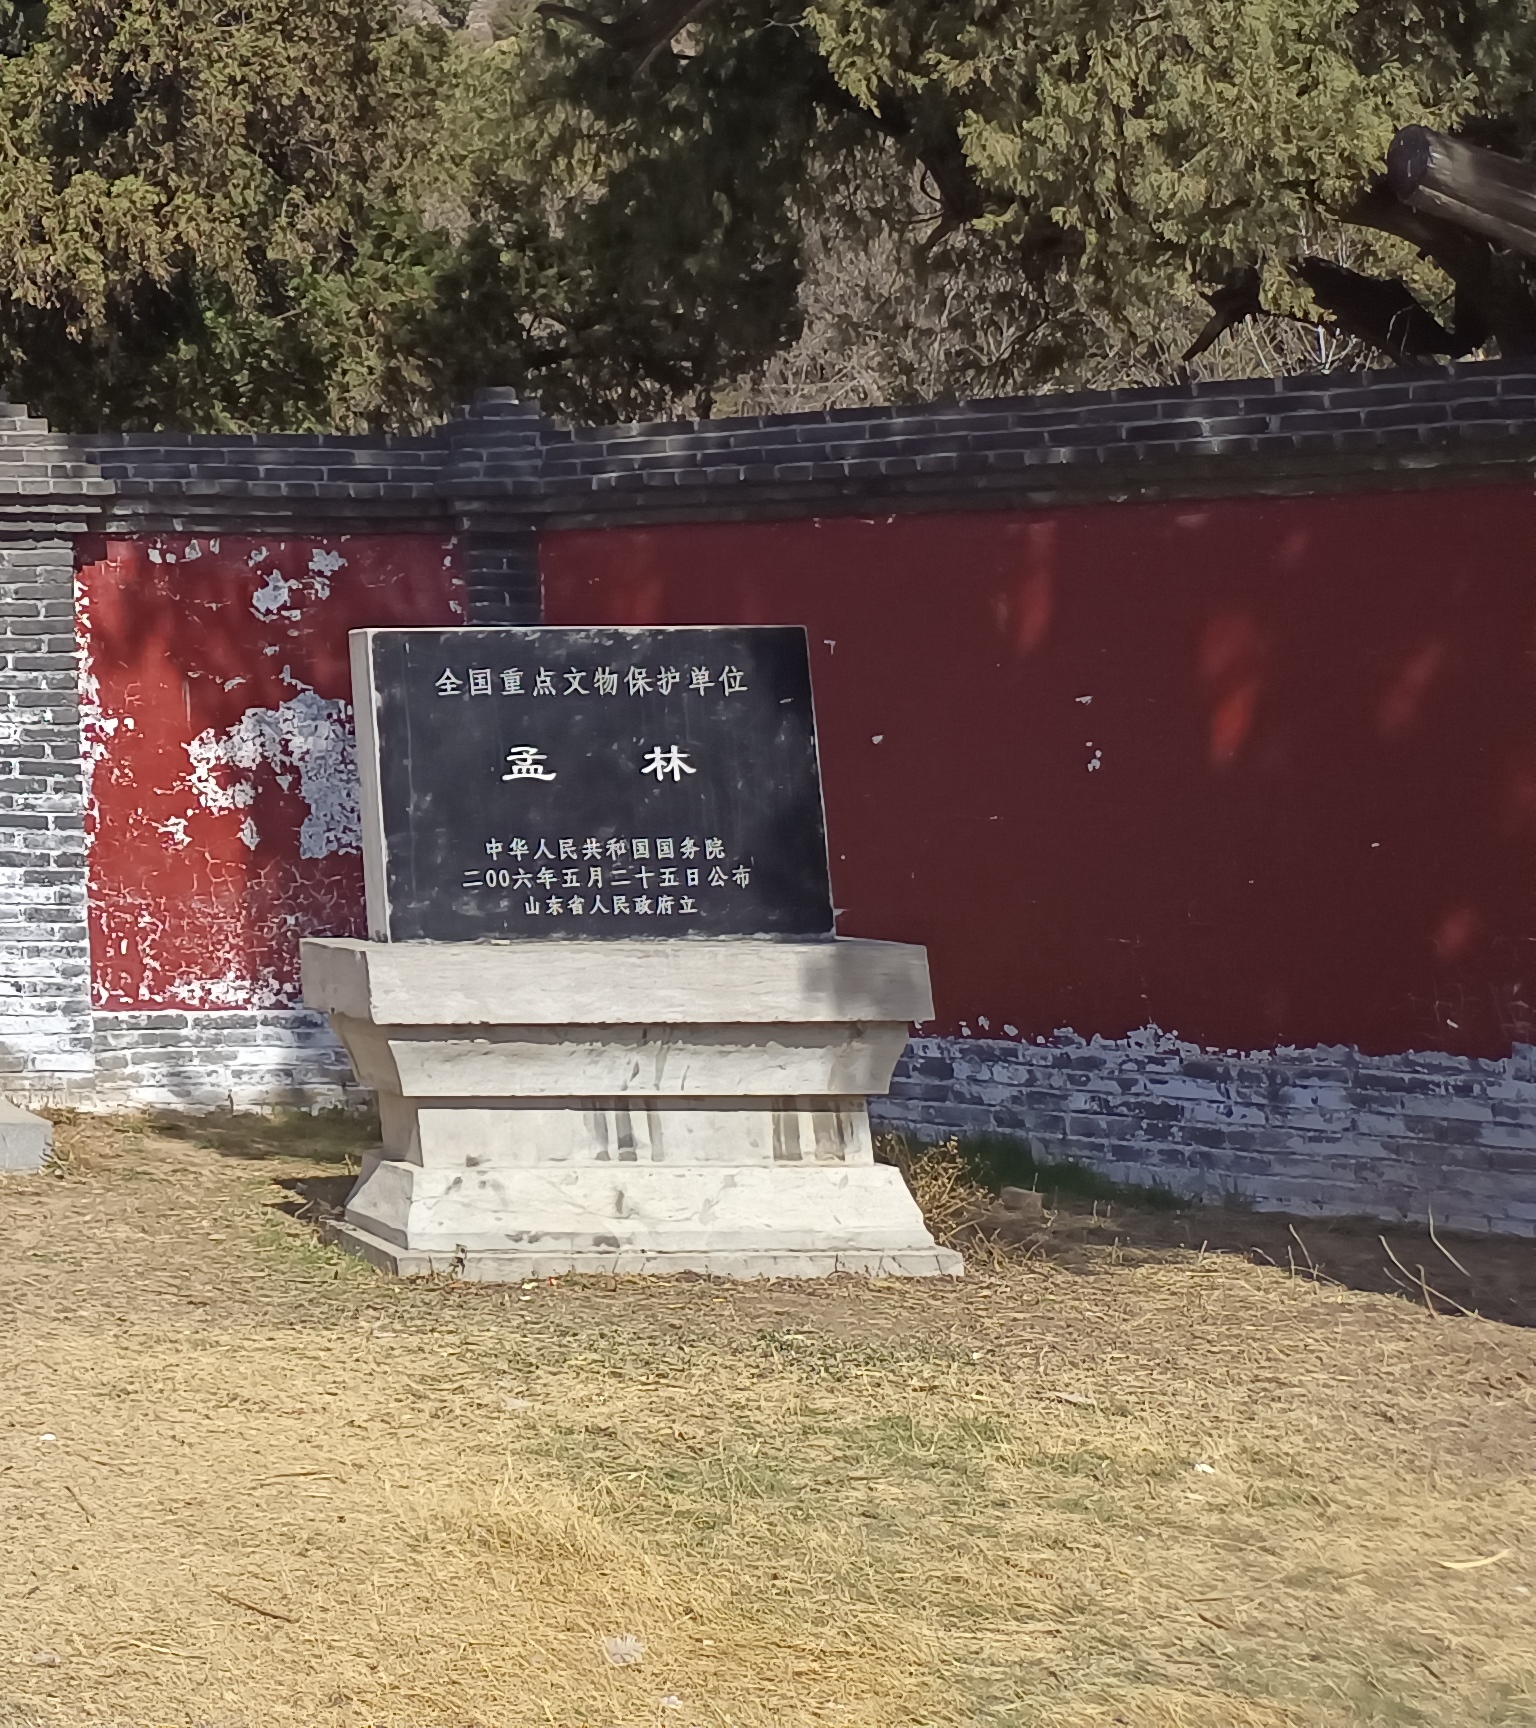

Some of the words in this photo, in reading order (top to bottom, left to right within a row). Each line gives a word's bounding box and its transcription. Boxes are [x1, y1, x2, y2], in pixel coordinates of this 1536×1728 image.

[434, 666, 749, 698] 全国重点文物保护单位
[501, 744, 698, 782] 孟林
[485, 837, 726, 861] 中华人民共和国国务院
[524, 895, 699, 916] 山东省人民政府立
